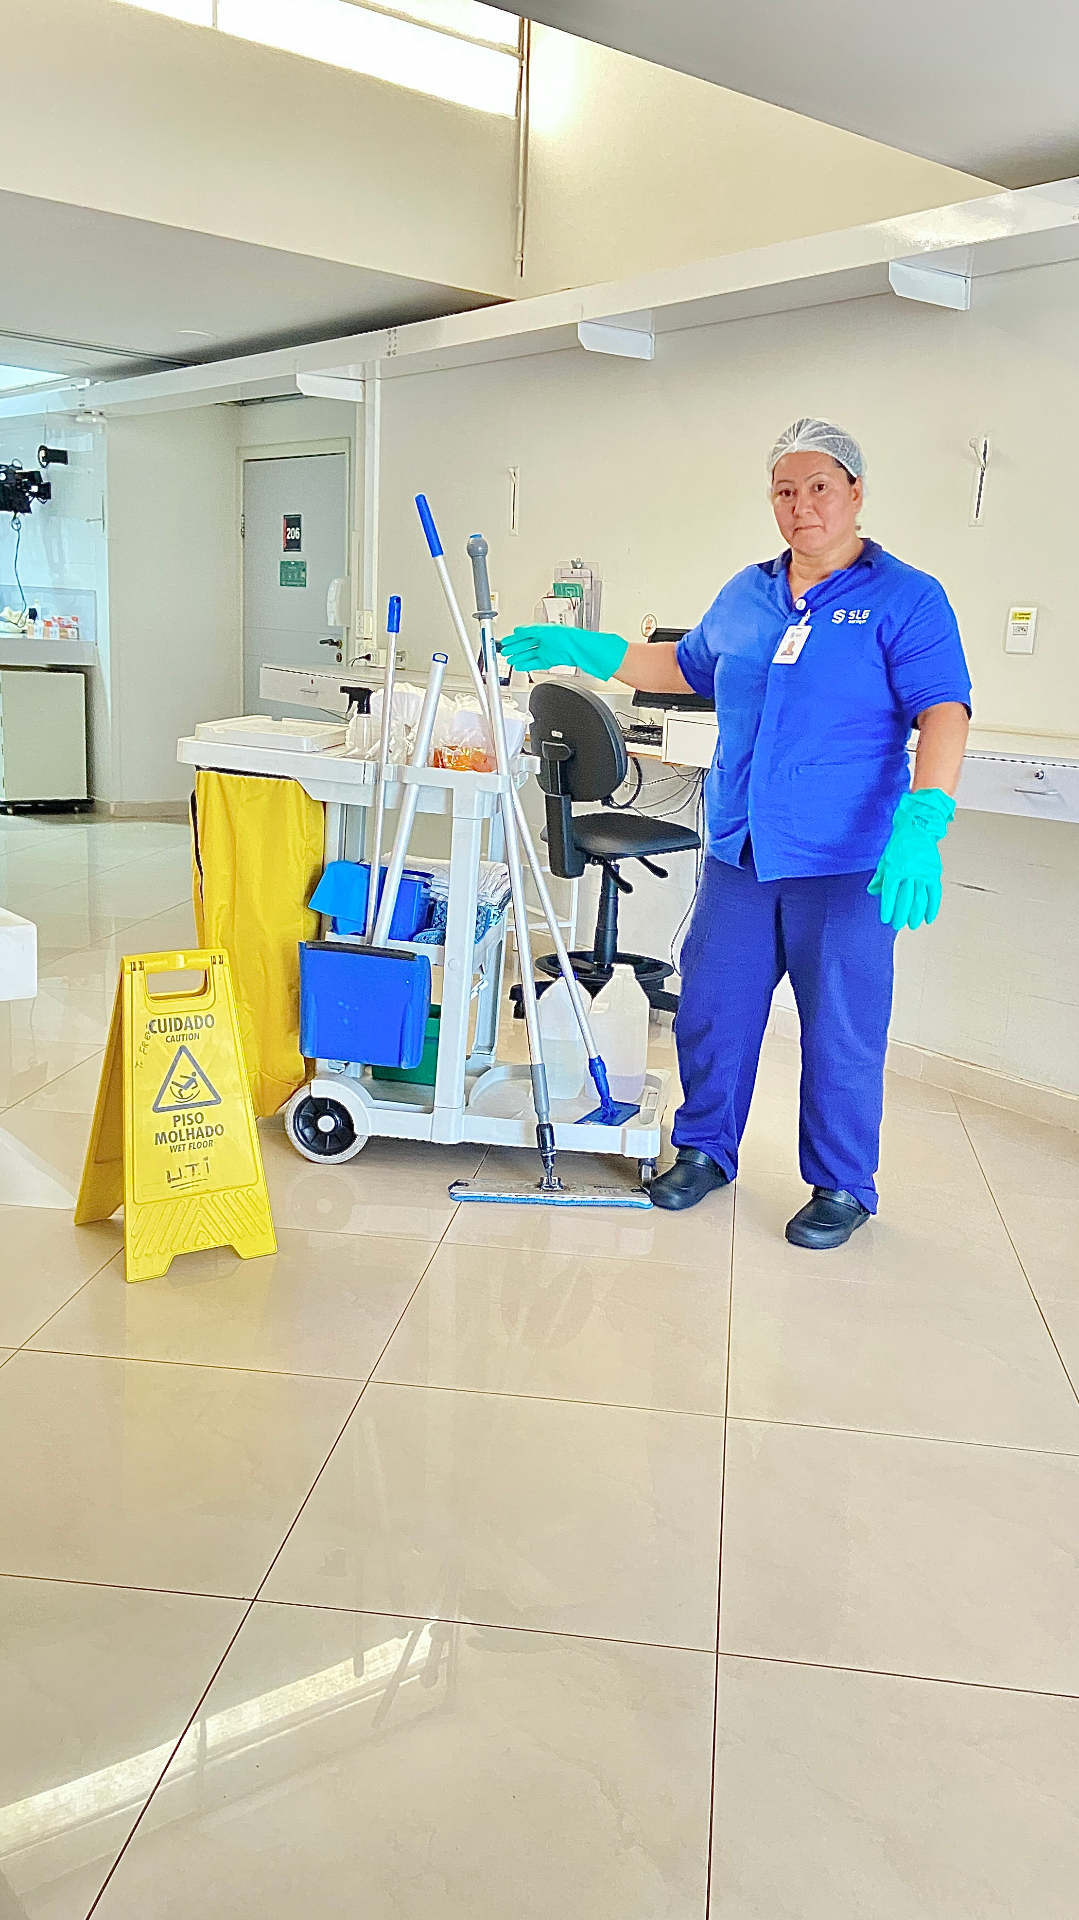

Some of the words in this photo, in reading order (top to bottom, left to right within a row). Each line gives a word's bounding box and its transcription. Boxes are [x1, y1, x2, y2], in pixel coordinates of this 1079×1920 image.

[286, 528, 300, 539] 206
[848, 609, 872, 619] SLG
[148, 1014, 215, 1035] CUIDADO
[165, 1032, 200, 1043] CAUTION
[172, 1112, 204, 1128] PISO
[154, 1123, 225, 1146] MOLHADO
[169, 1143, 186, 1154] WET
[188, 1139, 214, 1151] FLOOR
